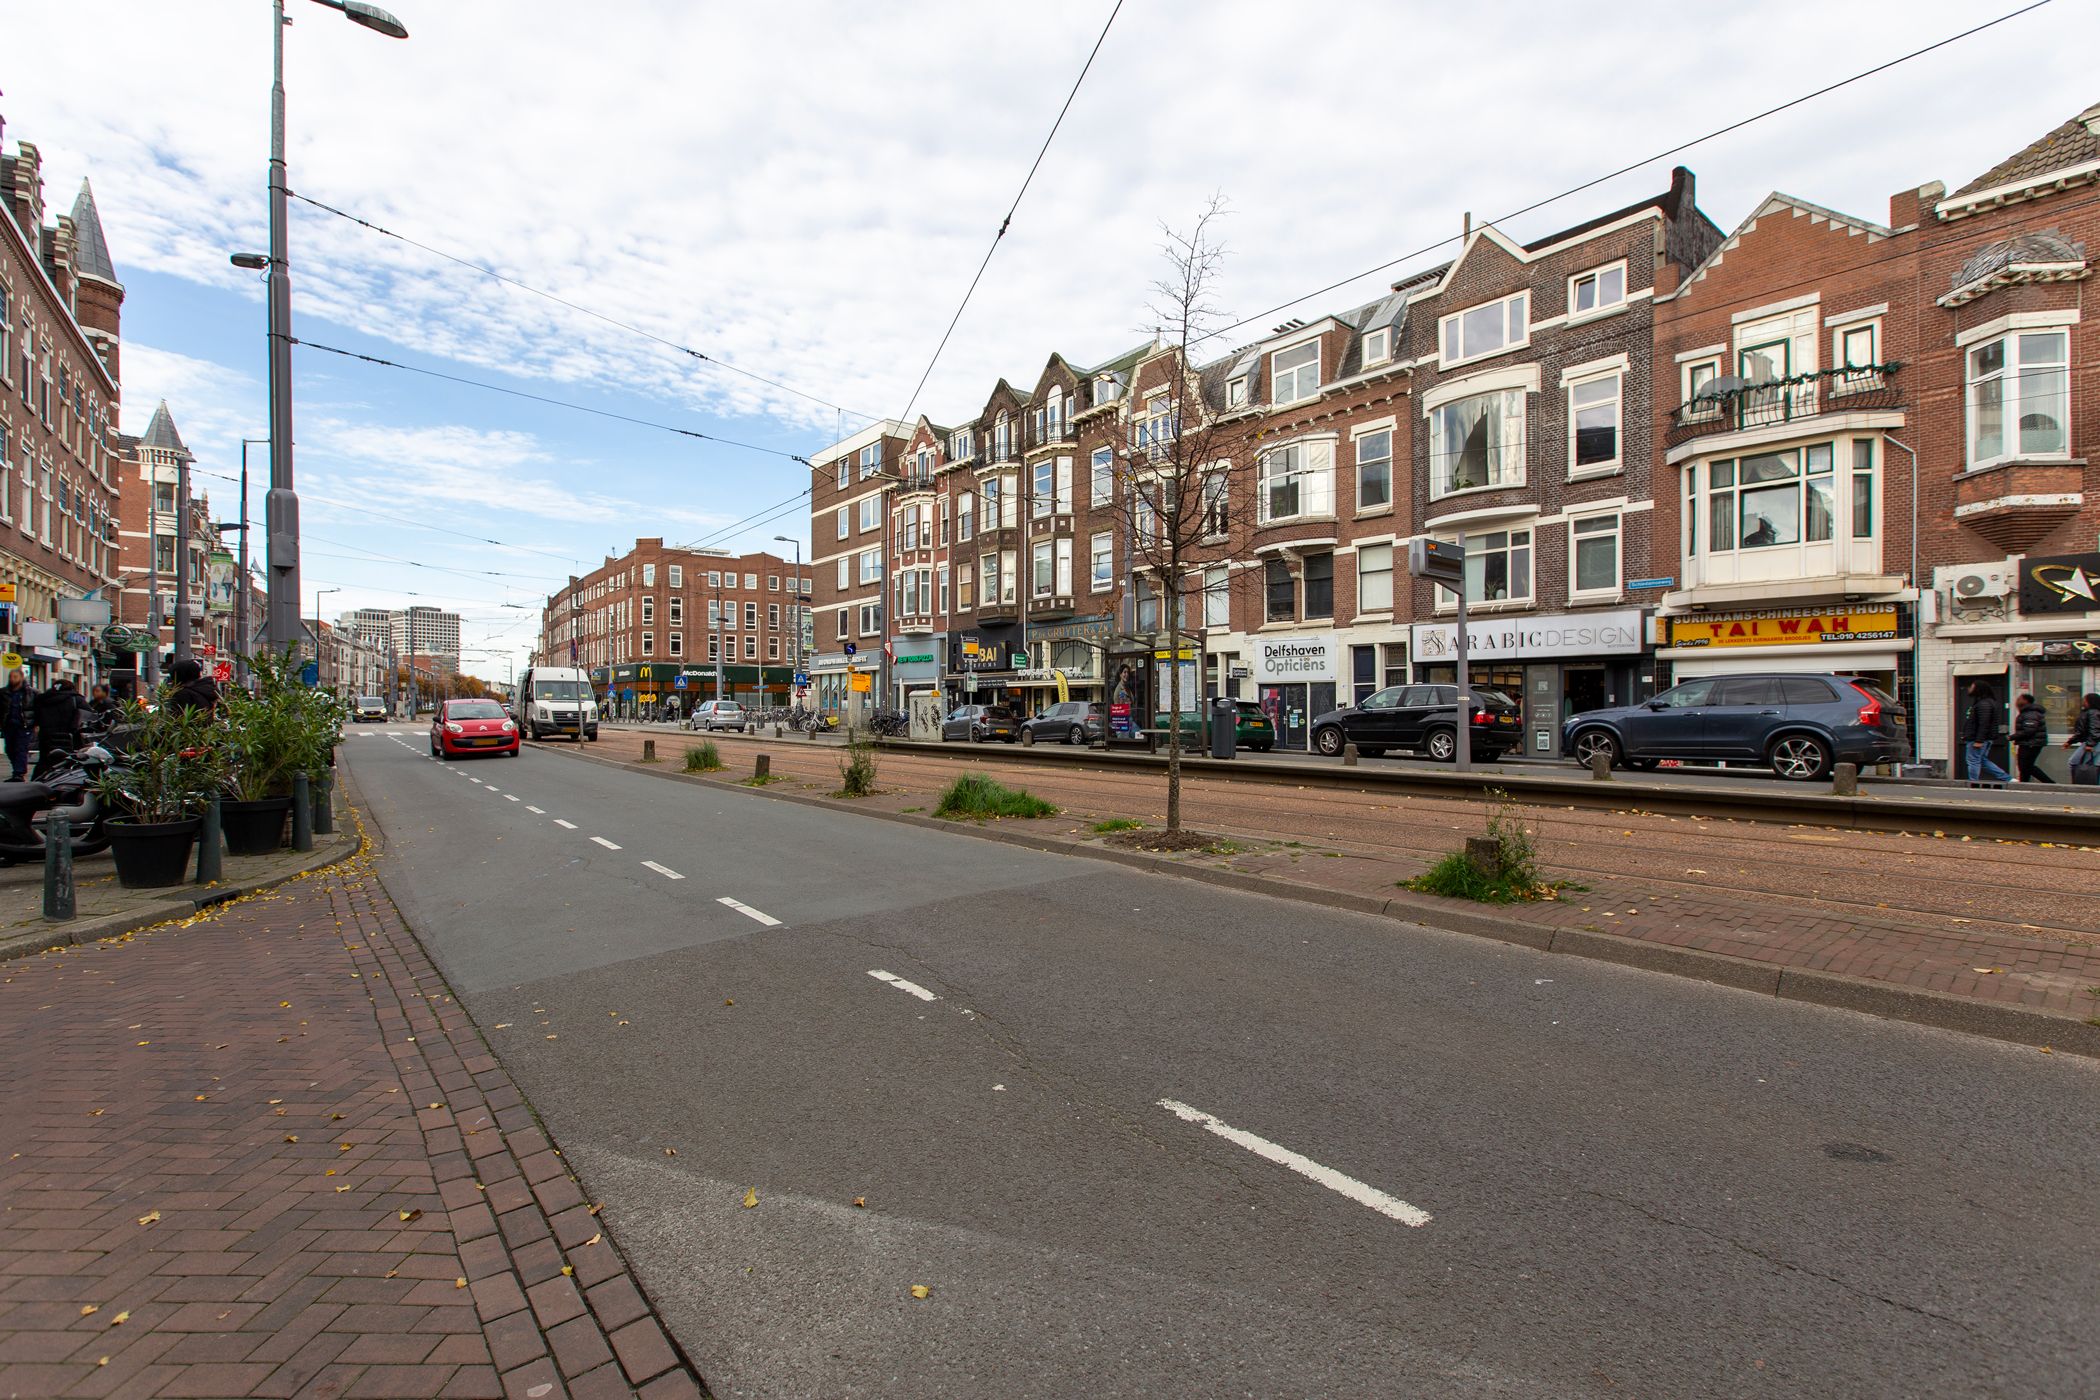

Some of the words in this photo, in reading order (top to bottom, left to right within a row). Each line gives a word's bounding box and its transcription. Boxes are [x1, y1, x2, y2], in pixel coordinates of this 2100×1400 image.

[1673, 602, 1896, 625] SURINAAMS-CHINEES-EETHUIS
[1709, 621, 1759, 637] TAI
[1778, 617, 1849, 635] WAH
[1855, 631, 1895, 641] 4256147
[1449, 630, 1542, 651] ARABIC
[1546, 626, 1635, 647] DESIGN
[1264, 644, 1326, 658] Delfshaven
[1265, 657, 1326, 676] Opticiëns
